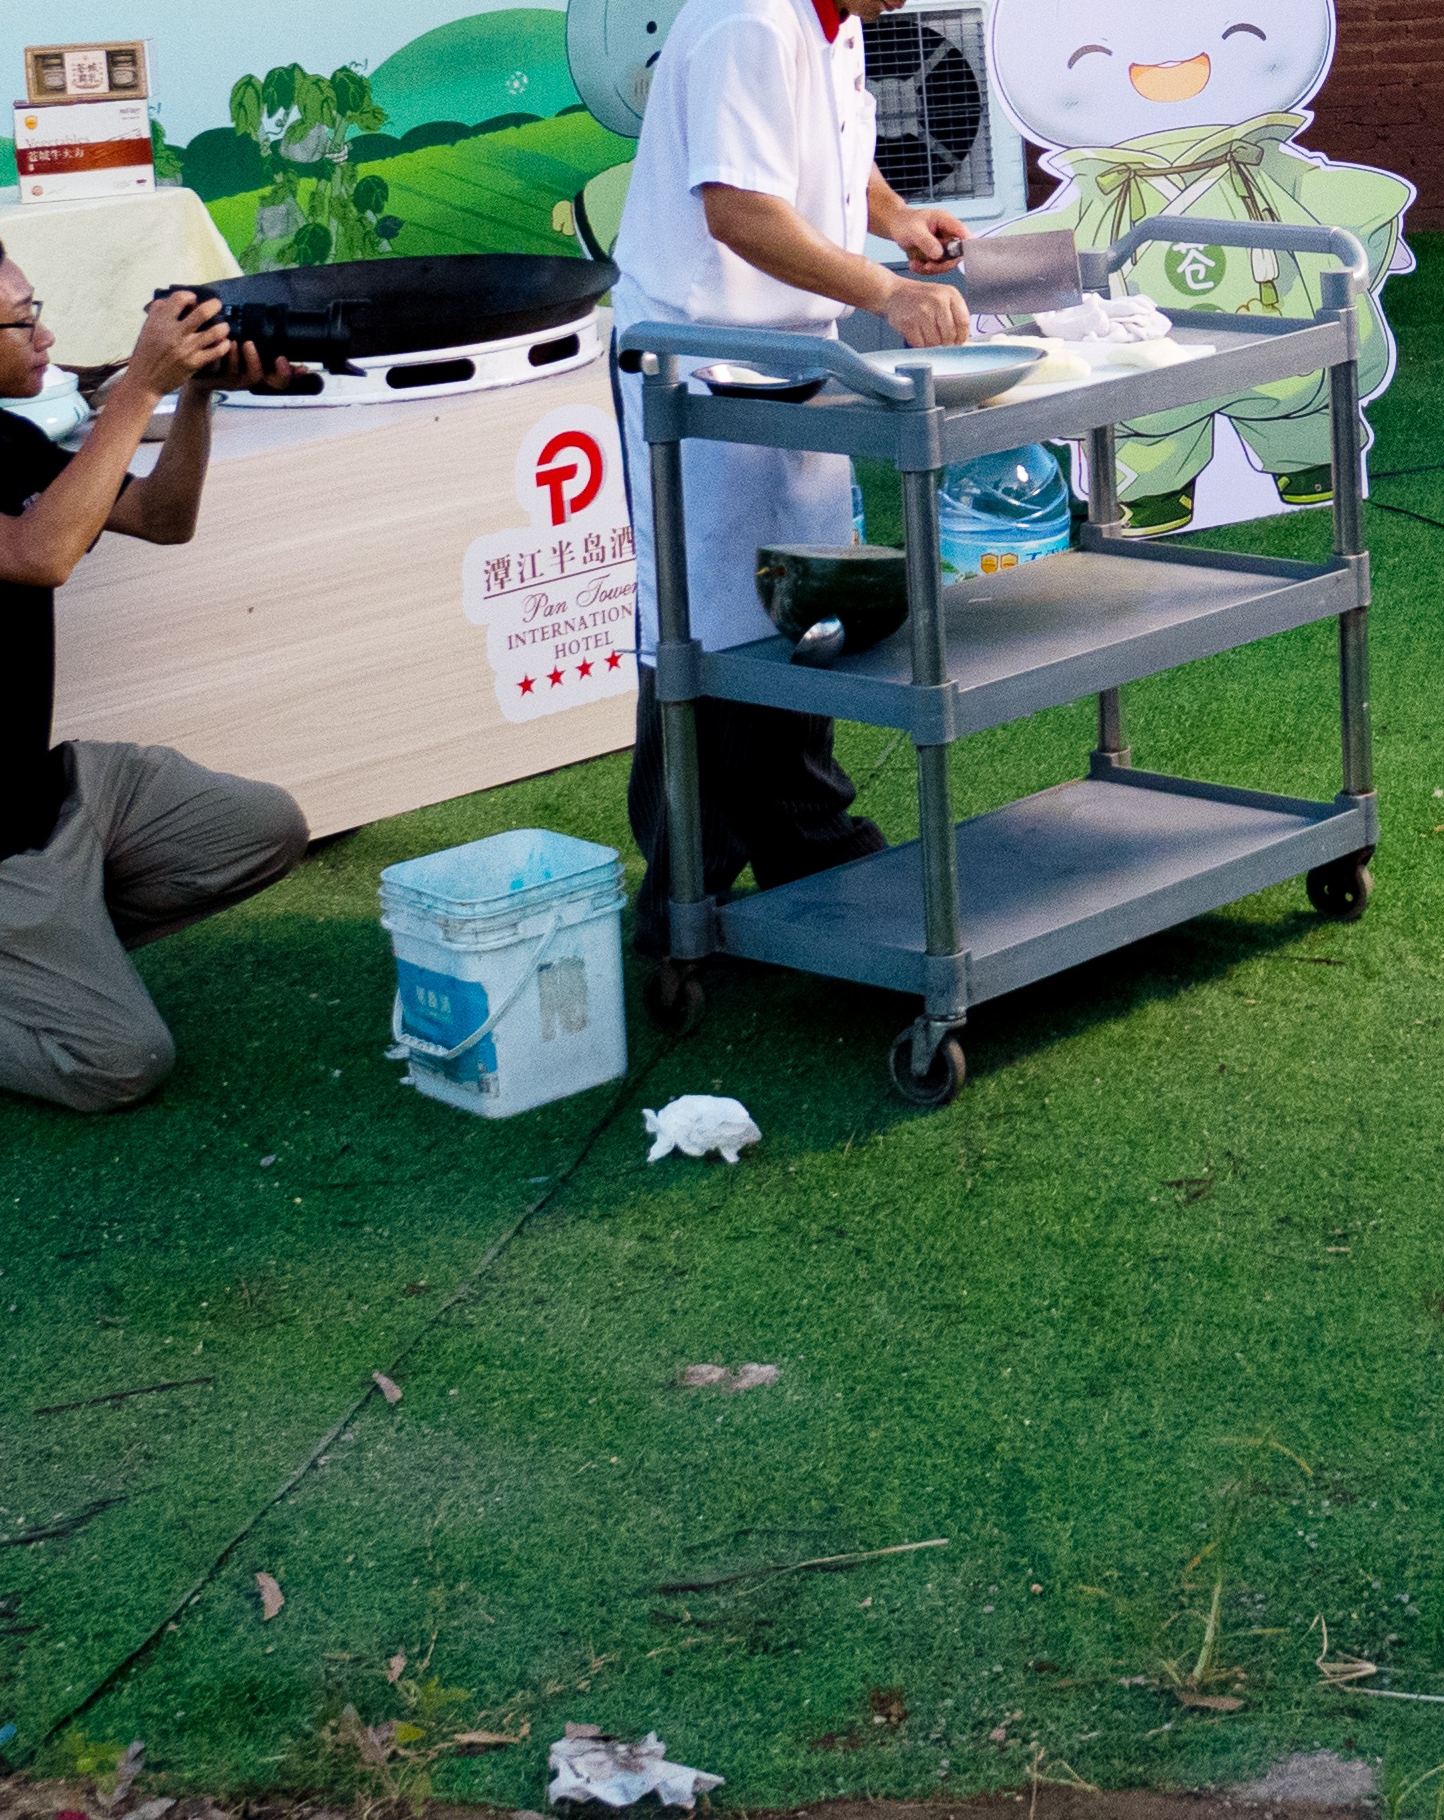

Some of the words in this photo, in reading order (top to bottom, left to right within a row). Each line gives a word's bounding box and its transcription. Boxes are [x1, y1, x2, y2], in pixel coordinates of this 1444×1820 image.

[1172, 242, 1216, 290] 苍
[484, 525, 636, 592] 潭江半岛酒
[523, 592, 569, 623] Pan
[554, 631, 614, 659] HOTEL
